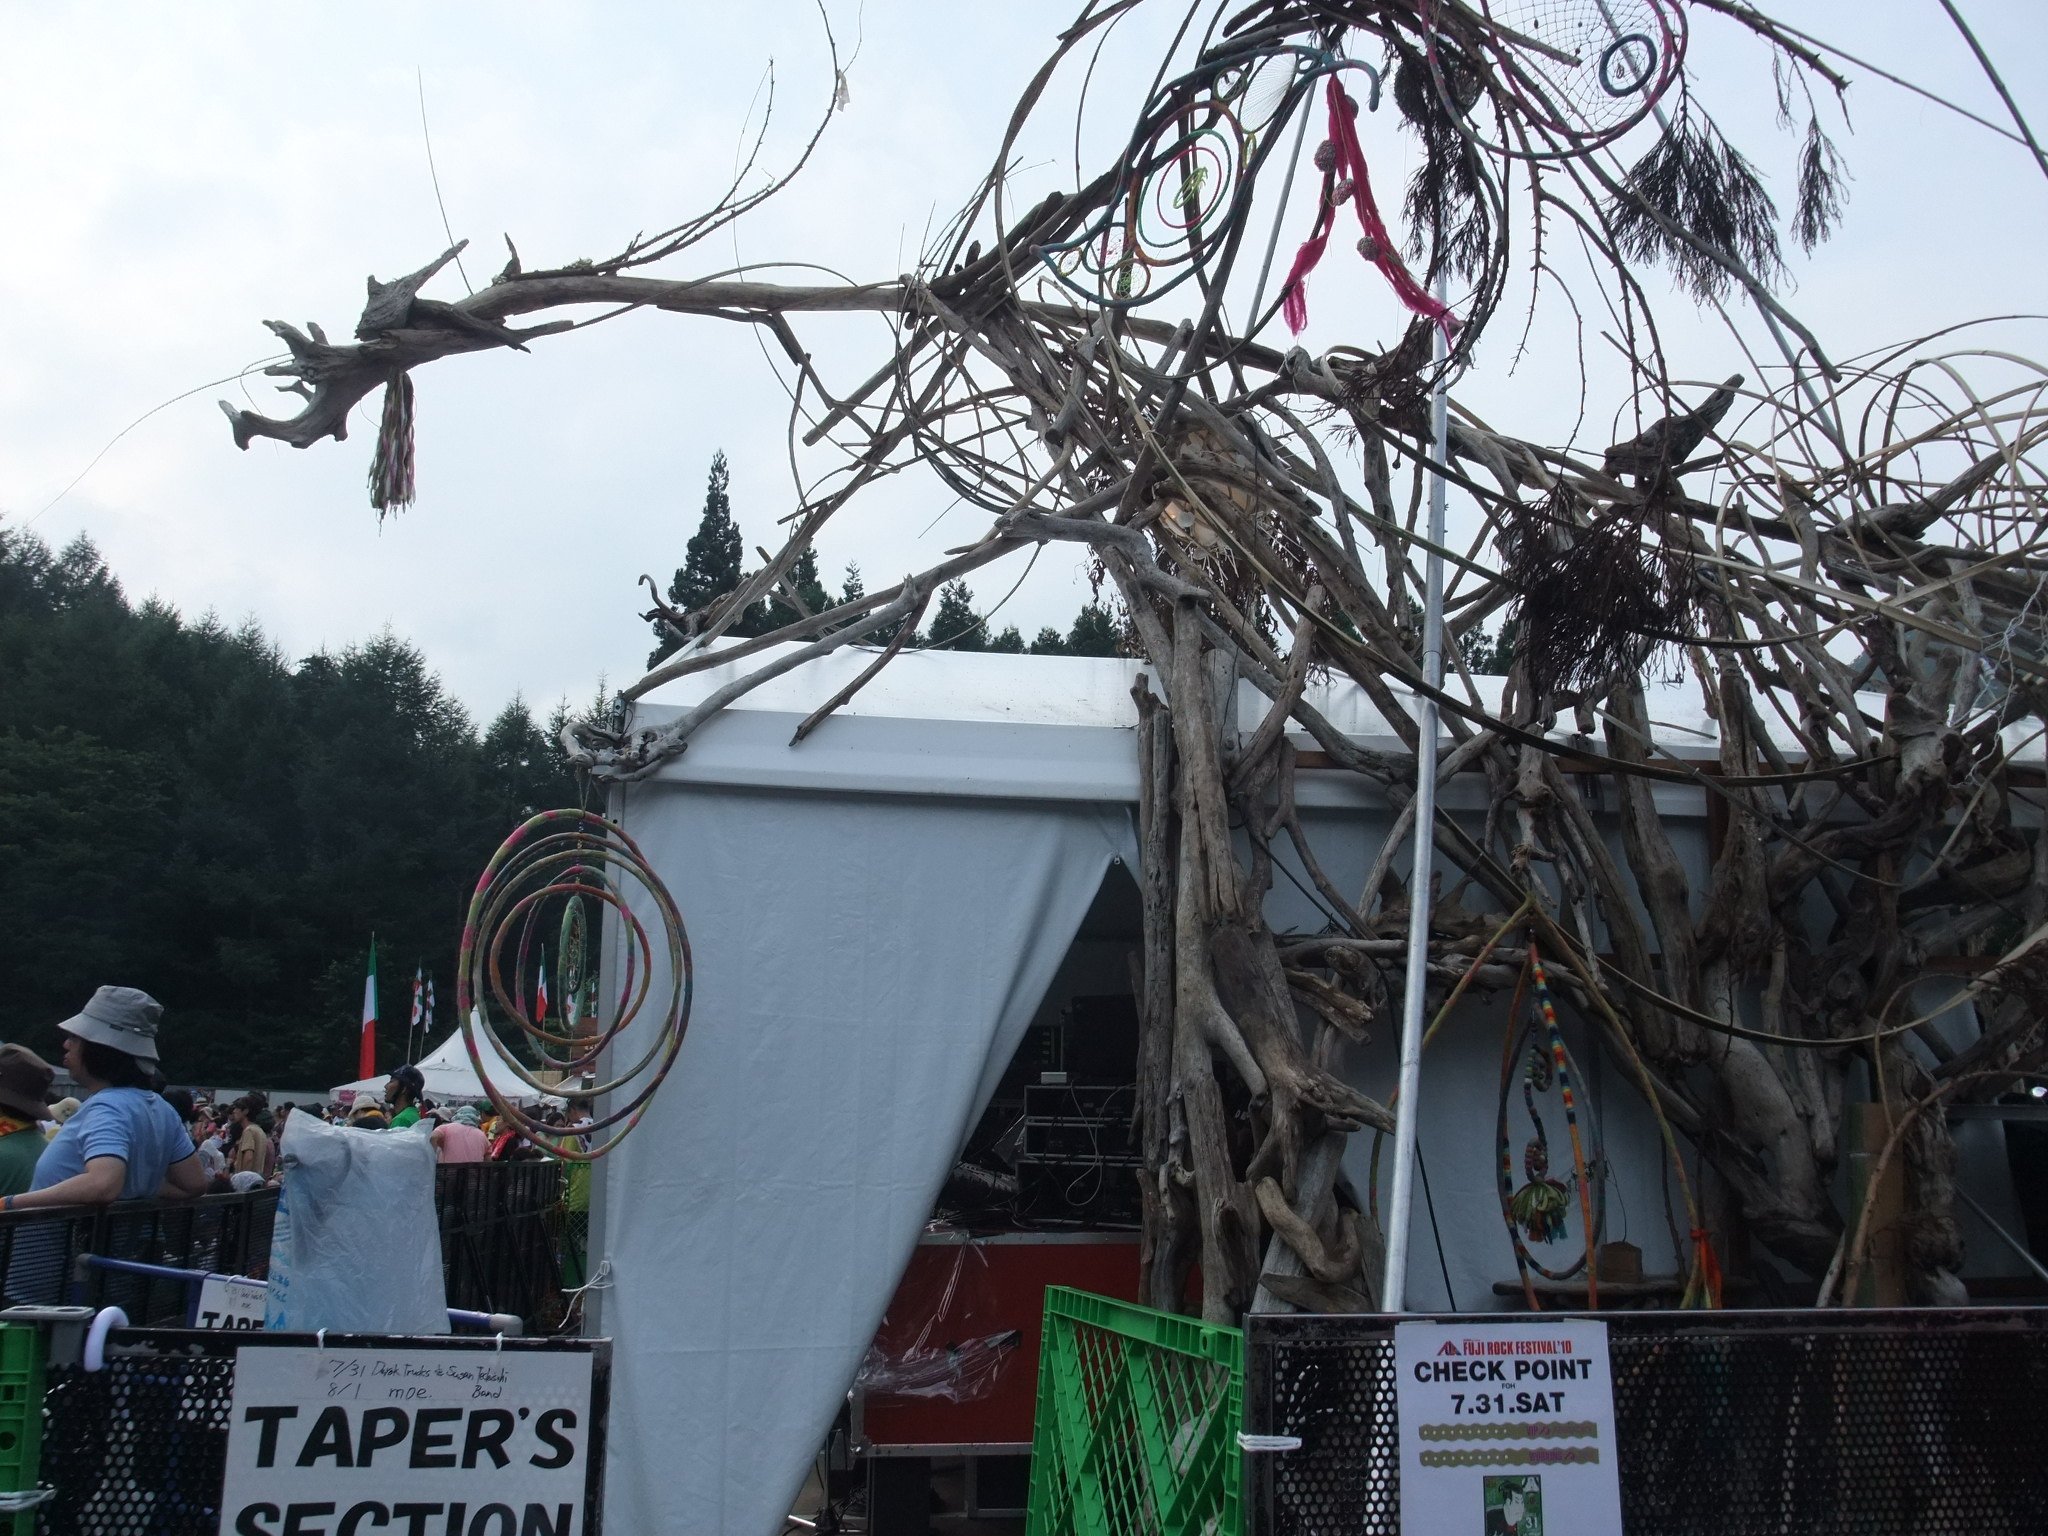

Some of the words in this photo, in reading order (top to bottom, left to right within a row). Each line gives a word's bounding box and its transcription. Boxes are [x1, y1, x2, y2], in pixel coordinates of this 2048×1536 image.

[1463, 1341, 1485, 1356] FUJI
[1487, 1341, 1514, 1356] ROCK
[328, 1359, 365, 1378] 7/31
[1414, 1361, 1506, 1383] CHECK
[1514, 1359, 1592, 1380] POINT
[327, 1382, 361, 1400] 8/1
[472, 1384, 502, 1399] Band
[1451, 1392, 1565, 1414] 7.31.SAT
[244, 1406, 577, 1469] TAPER'S
[235, 1501, 573, 1536] SECTION
